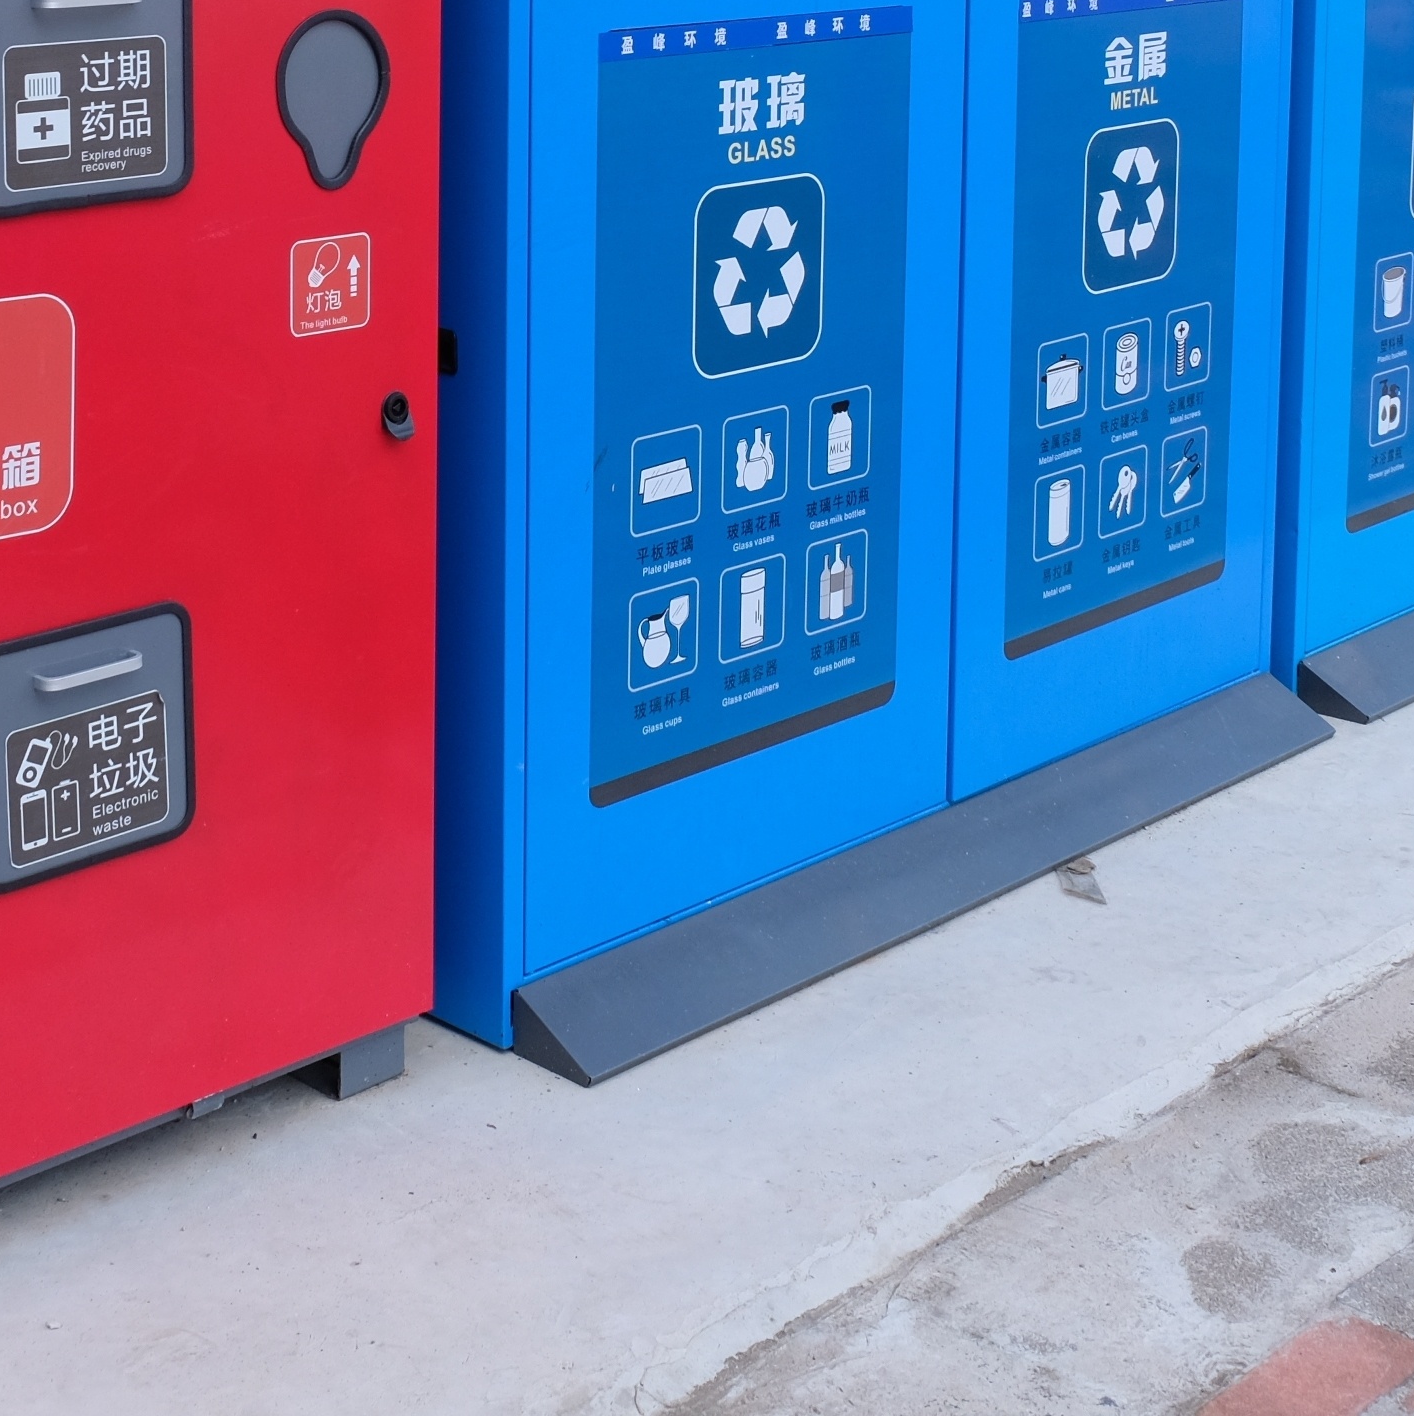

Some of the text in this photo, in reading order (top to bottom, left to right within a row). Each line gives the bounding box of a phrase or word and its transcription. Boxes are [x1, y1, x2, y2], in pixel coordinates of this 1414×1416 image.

[621, 14, 872, 55] 盈峰环境 盈峰环境
[79, 50, 151, 93] 过期
[1104, 31, 1167, 85] 金属
[718, 71, 806, 135] 玻璃
[1110, 86, 1159, 111] METAL
[81, 98, 153, 143] 药品
[81, 145, 153, 165] Expired drugs
[728, 135, 796, 165] GLASS
[81, 159, 127, 173] recovery
[306, 289, 342, 313] 灯泡
[300, 316, 348, 330] The light bulb
[829, 440, 850, 455] MILK
[0, 494, 39, 522] box
[805, 486, 871, 518] 玻璃牛奶瓶
[727, 511, 781, 541] 玻璃花瓶
[809, 508, 865, 529] Glass milk bottles
[636, 534, 694, 565] 平板玻璃
[732, 534, 774, 551] Glass vases
[642, 556, 691, 575] Plate glasses
[810, 631, 861, 661] 玻璃酒瓶
[724, 659, 778, 691] 玻璃容器
[813, 654, 855, 675] Glass bottles
[633, 687, 691, 720] 玻璃杯具
[721, 681, 779, 706] Glass containers
[87, 701, 159, 753] 电子
[642, 716, 682, 734] Glass cups
[88, 748, 161, 801] 垃圾
[92, 786, 160, 820] Electronic
[92, 814, 133, 837] waste
